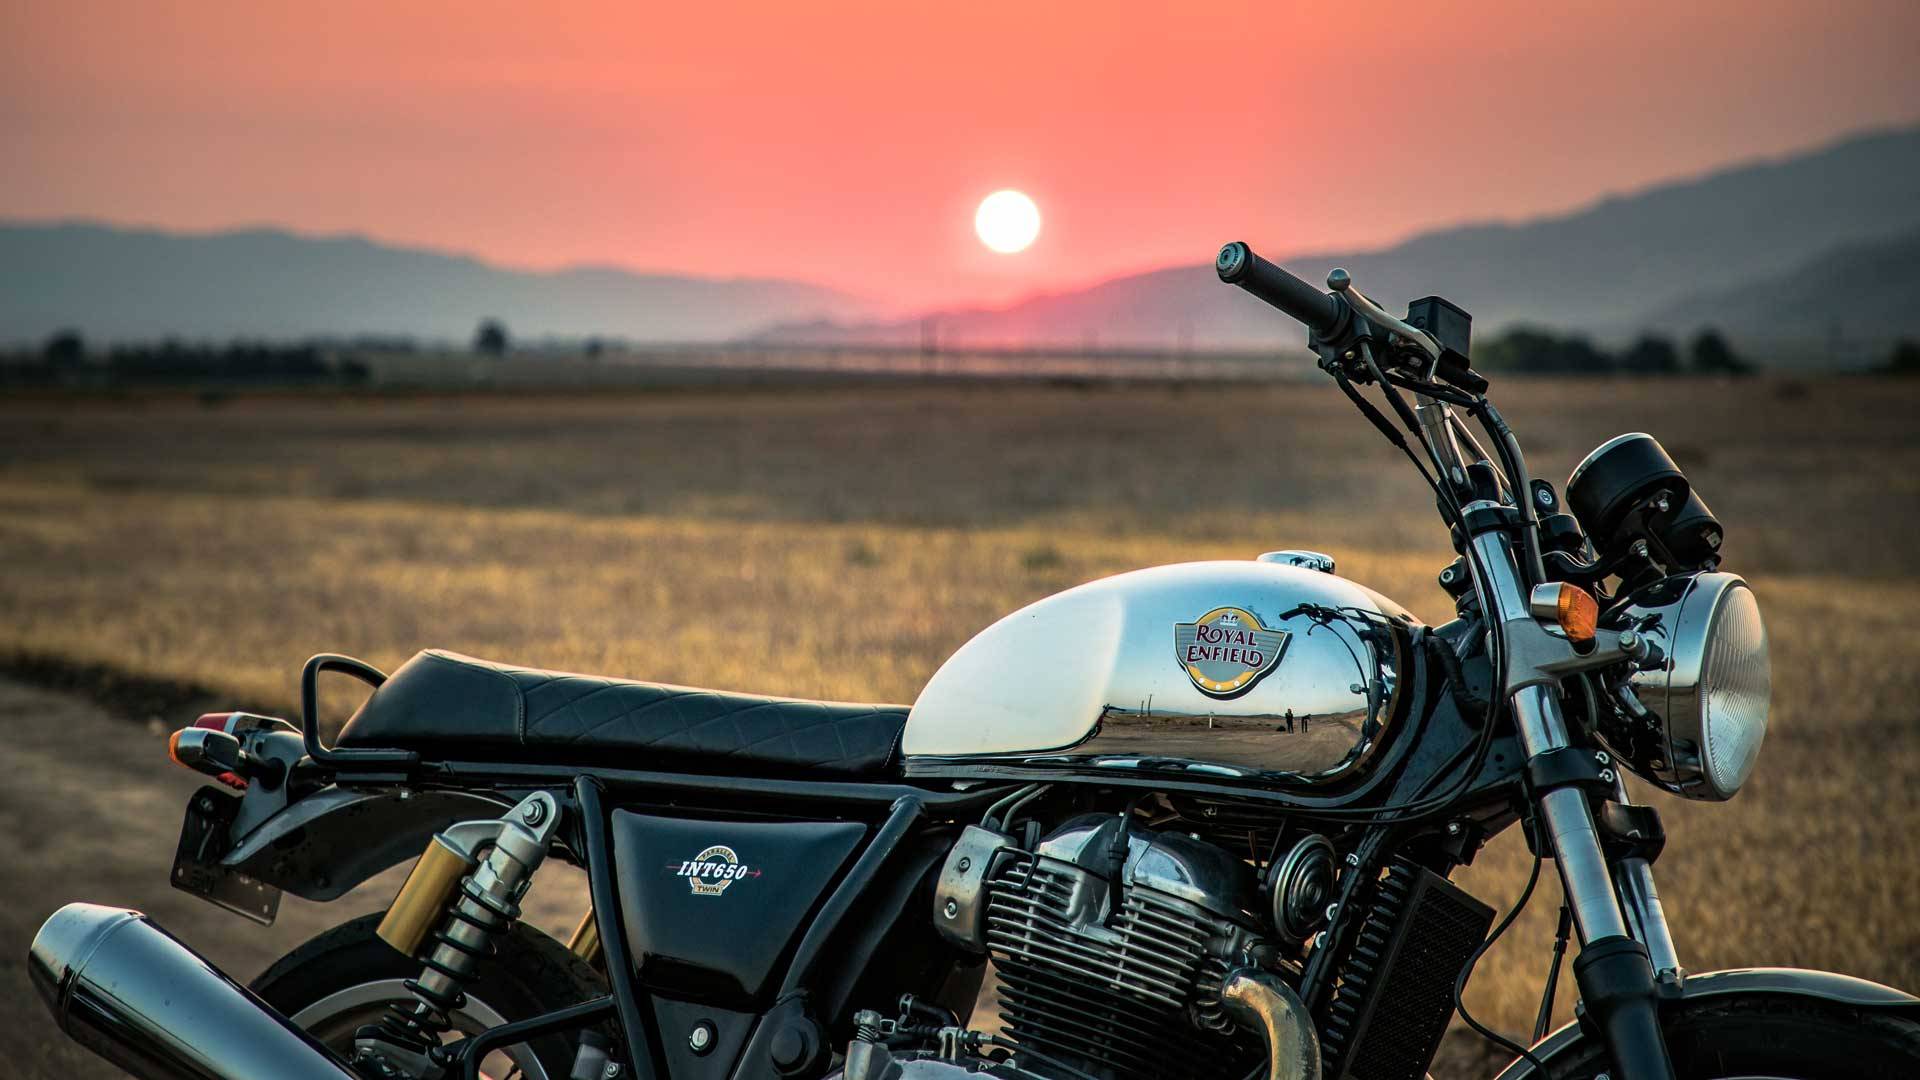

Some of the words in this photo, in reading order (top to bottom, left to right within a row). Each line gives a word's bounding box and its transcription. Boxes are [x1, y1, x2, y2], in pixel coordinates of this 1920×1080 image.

[1196, 625, 1258, 646] ROYAL
[1186, 645, 1264, 668] ENFIELD
[677, 861, 748, 880] INT650
[697, 885, 720, 893] TWIN
